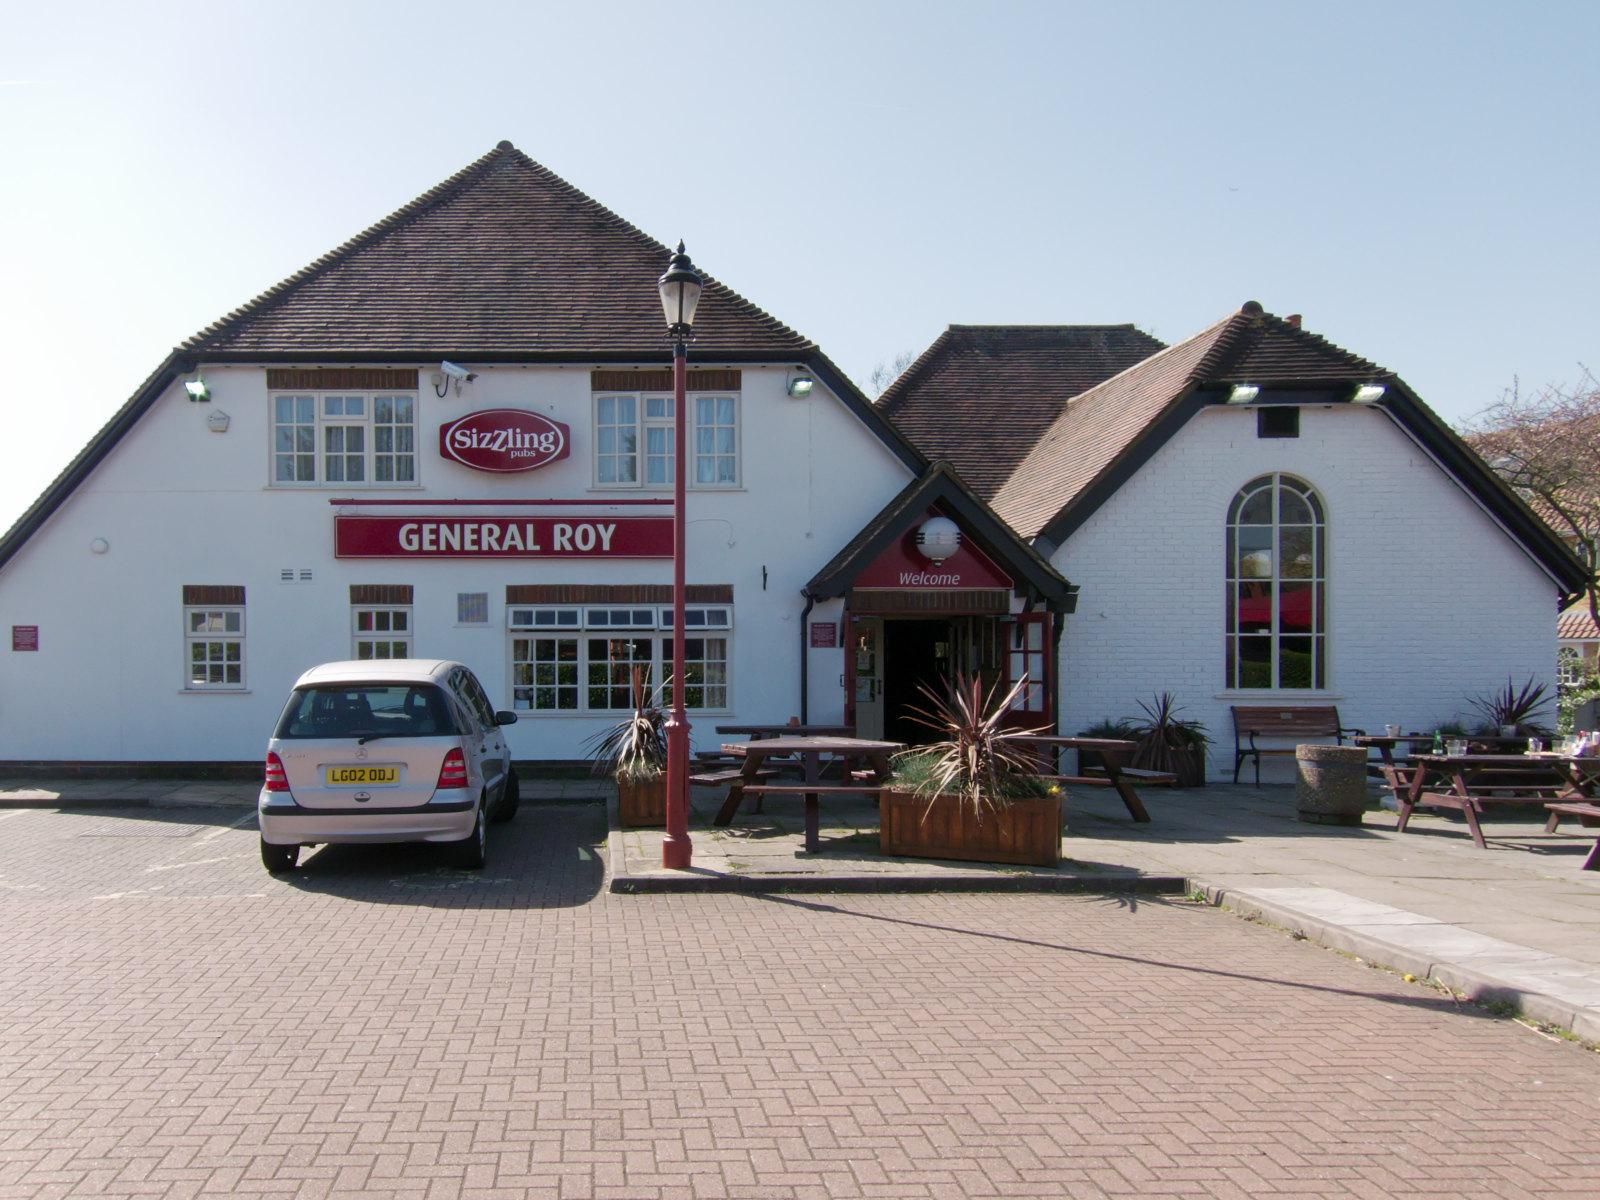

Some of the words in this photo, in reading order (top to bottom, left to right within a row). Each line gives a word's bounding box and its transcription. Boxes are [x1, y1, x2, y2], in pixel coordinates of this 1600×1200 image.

[511, 449, 536, 459] pubs
[399, 523, 540, 551] GENERAL
[553, 523, 616, 551] ROY
[900, 571, 960, 585] Welcome
[332, 769, 365, 781] LG02
